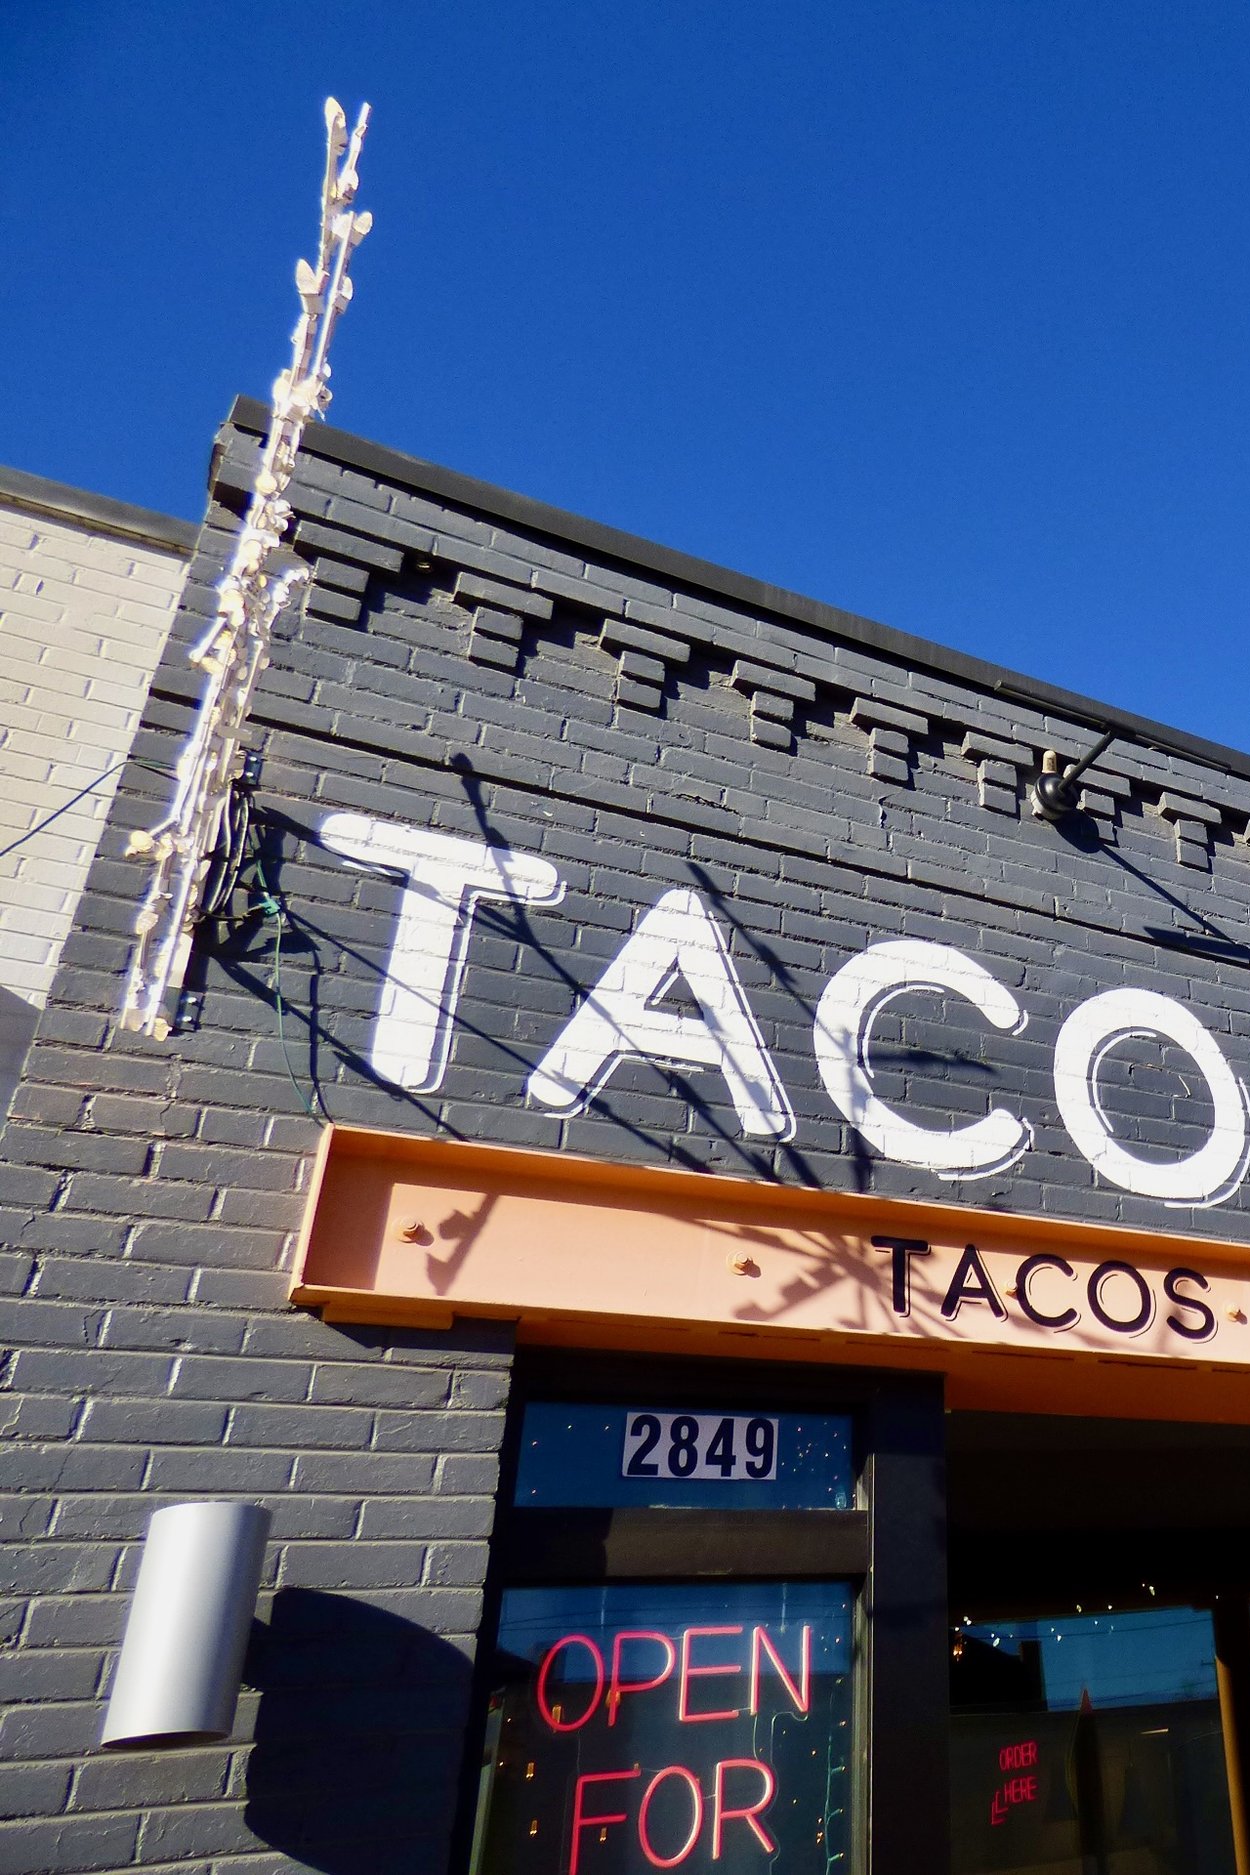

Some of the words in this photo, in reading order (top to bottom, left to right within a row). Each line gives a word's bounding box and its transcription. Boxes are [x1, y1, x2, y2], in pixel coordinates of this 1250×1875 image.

[870, 1235, 1219, 1345] TACOS
[626, 1413, 776, 1479] 2849
[536, 1624, 812, 1732] OPEN
[999, 1741, 1038, 1771] ORDER
[1004, 1776, 1038, 1804] HERE
[568, 1758, 776, 1875] FOR
